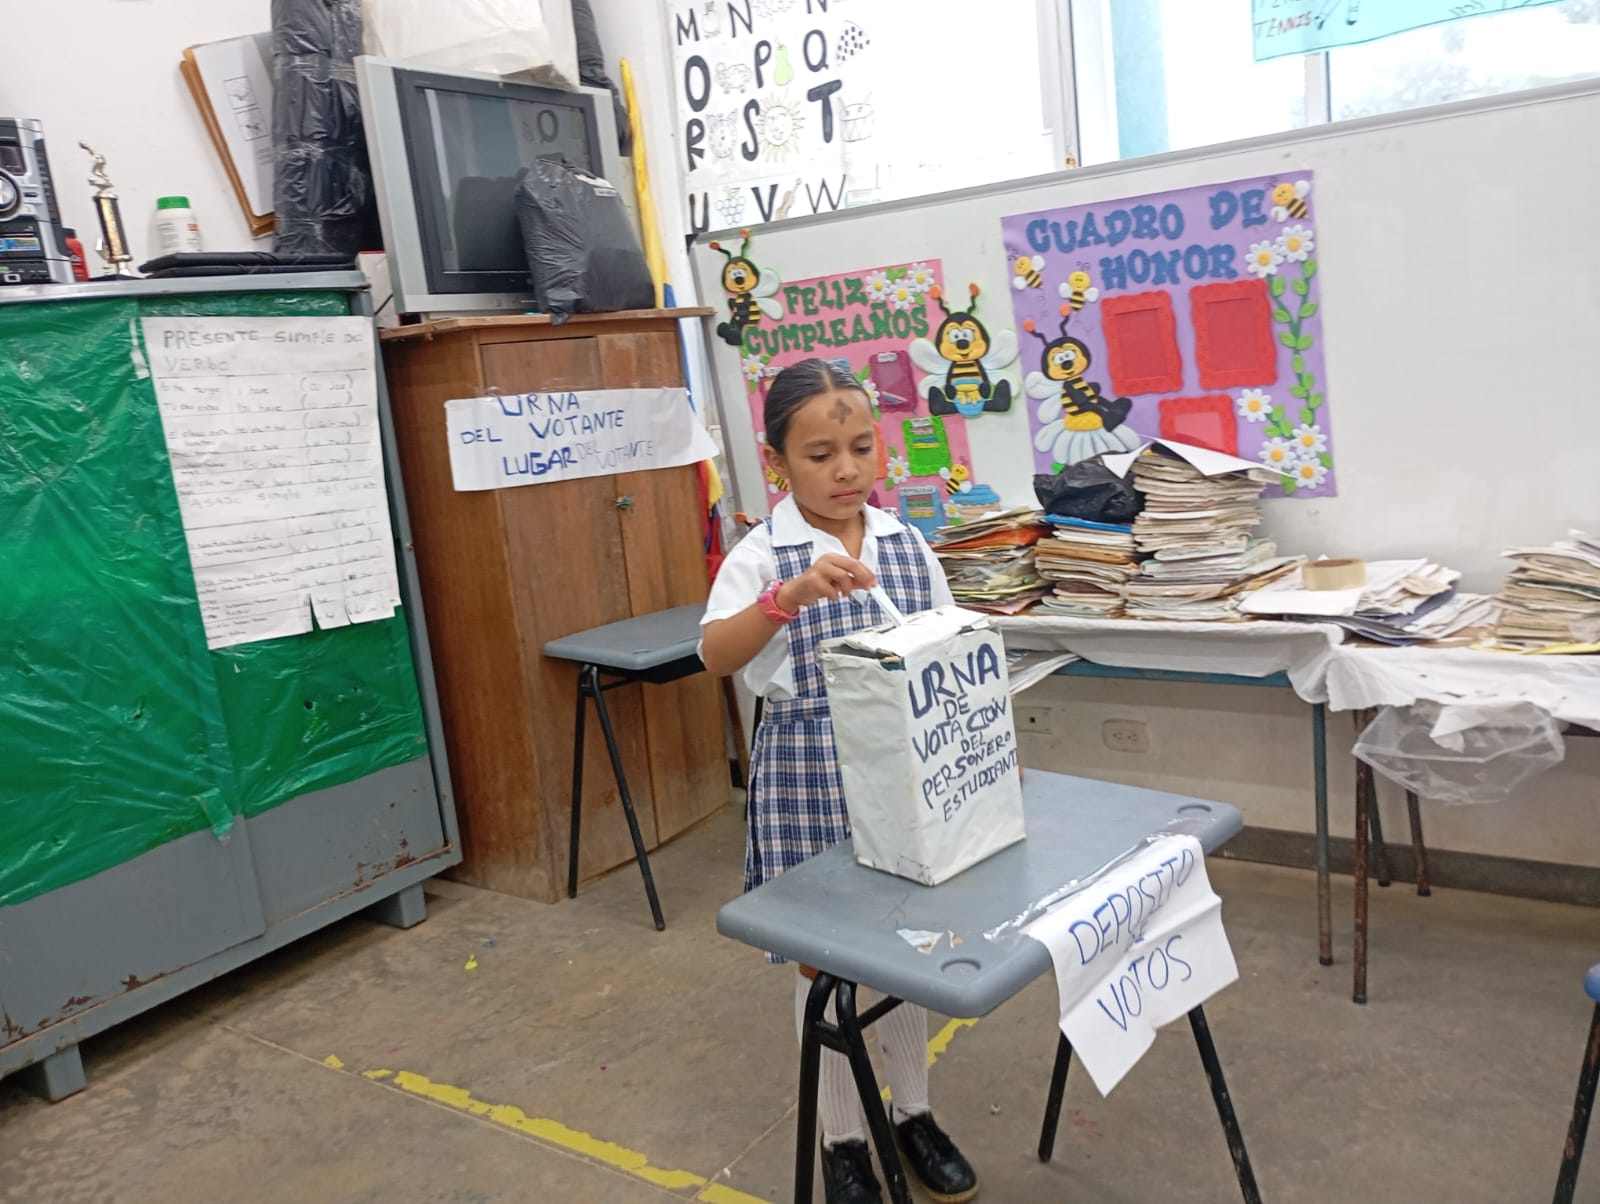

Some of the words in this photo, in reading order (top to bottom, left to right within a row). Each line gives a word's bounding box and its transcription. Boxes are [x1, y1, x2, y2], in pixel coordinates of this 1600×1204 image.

[676, 8, 700, 46] M
[727, 0, 753, 38] N
[684, 54, 711, 113] O
[753, 39, 772, 89] P
[803, 28, 829, 73] Q
[686, 117, 705, 173] R
[741, 98, 760, 162] S
[807, 79, 843, 143] T
[688, 192, 710, 234] U
[750, 184, 778, 222] V
[805, 174, 847, 214] W
[1026, 203, 1185, 254] CUADRO
[1208, 189, 1269, 230] DE
[1098, 244, 1239, 290] HONOR
[783, 278, 869, 316] FELIZ
[742, 299, 930, 356] CUMPLEAÑOS
[460, 427, 503, 445] DEL
[528, 409, 625, 440] VOTANTE
[497, 391, 581, 417] URNA
[502, 446, 579, 476] LUGAR
[908, 643, 1001, 720] URNA
[942, 693, 971, 721] DE
[960, 730, 986, 755] DEL
[921, 731, 1012, 810] PERSONERO
[1096, 934, 1192, 1032] VOTOS
